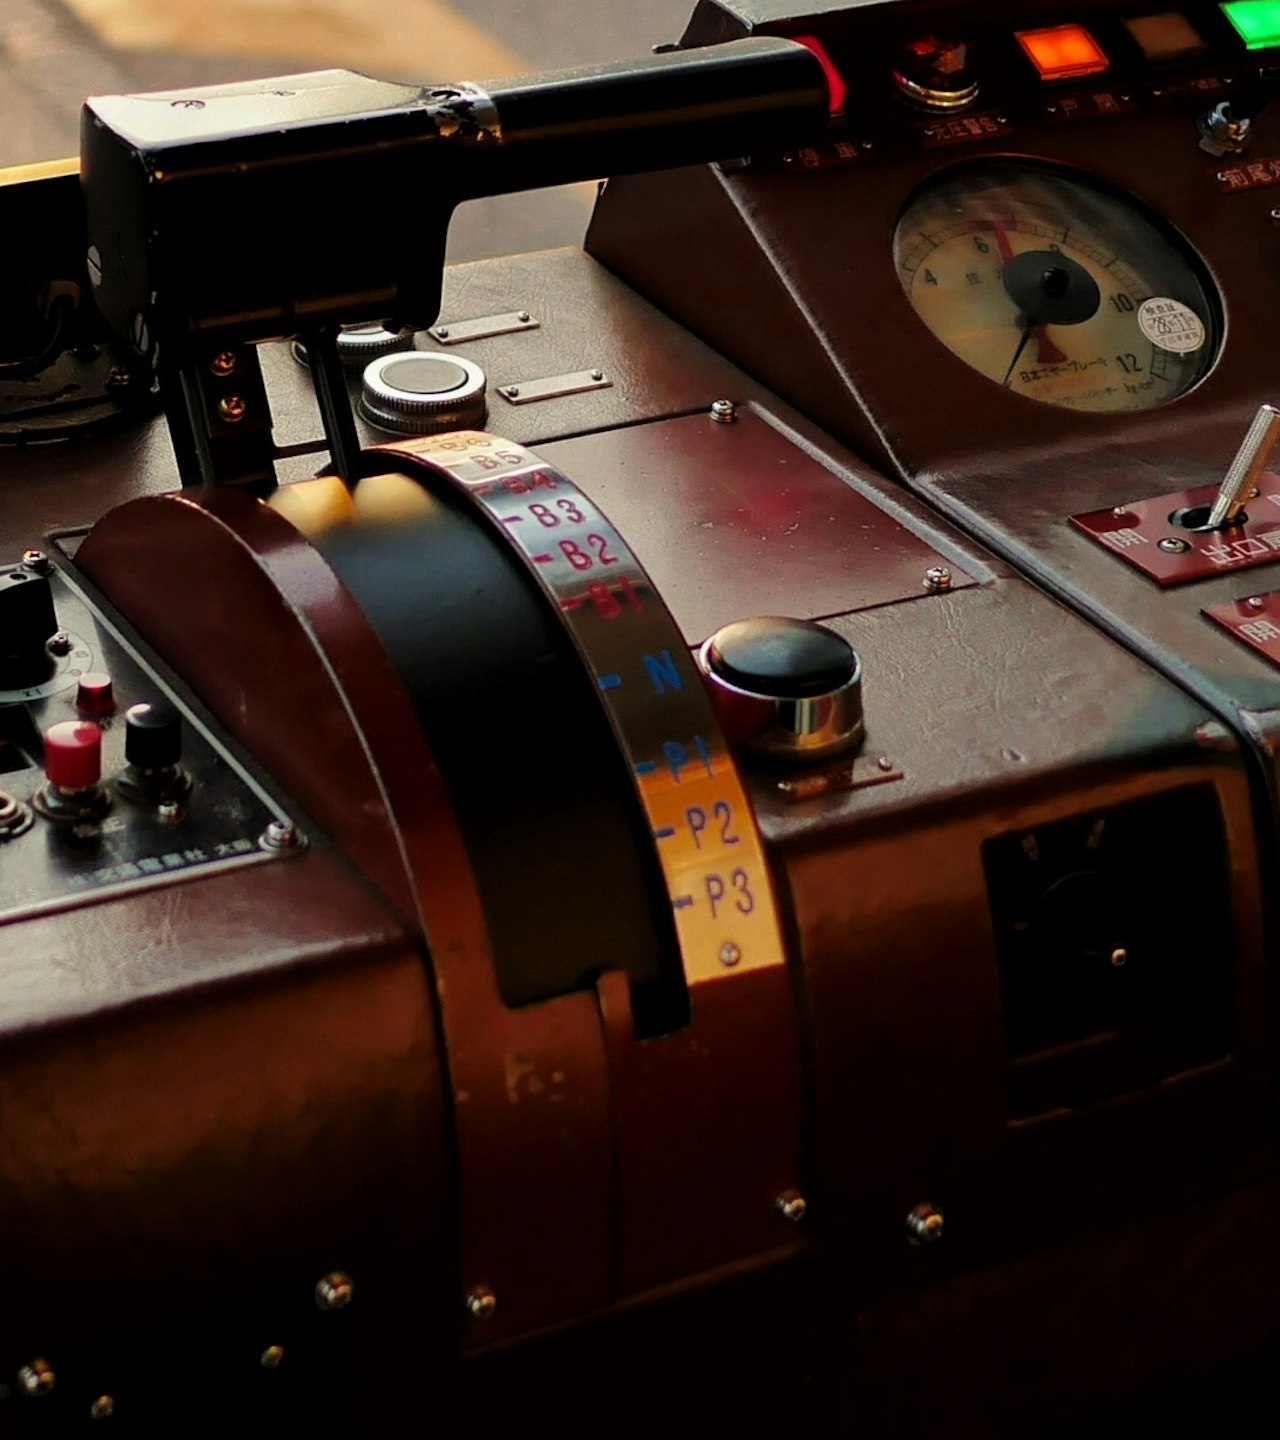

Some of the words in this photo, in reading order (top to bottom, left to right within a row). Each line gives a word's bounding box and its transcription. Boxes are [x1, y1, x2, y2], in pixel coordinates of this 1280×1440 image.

[973, 236, 990, 254] 6
[924, 268, 938, 286] 4
[1109, 292, 1136, 313] 10
[1116, 352, 1143, 374] 12
[470, 450, 524, 470] B5
[501, 471, 558, 496] B4
[527, 499, 586, 528] B3
[1103, 527, 1150, 549] 開
[557, 533, 619, 571] B2
[587, 575, 644, 619] B1
[642, 649, 684, 694] N
[662, 734, 715, 784] P1
[686, 800, 740, 849] P2
[705, 867, 755, 919] P3
